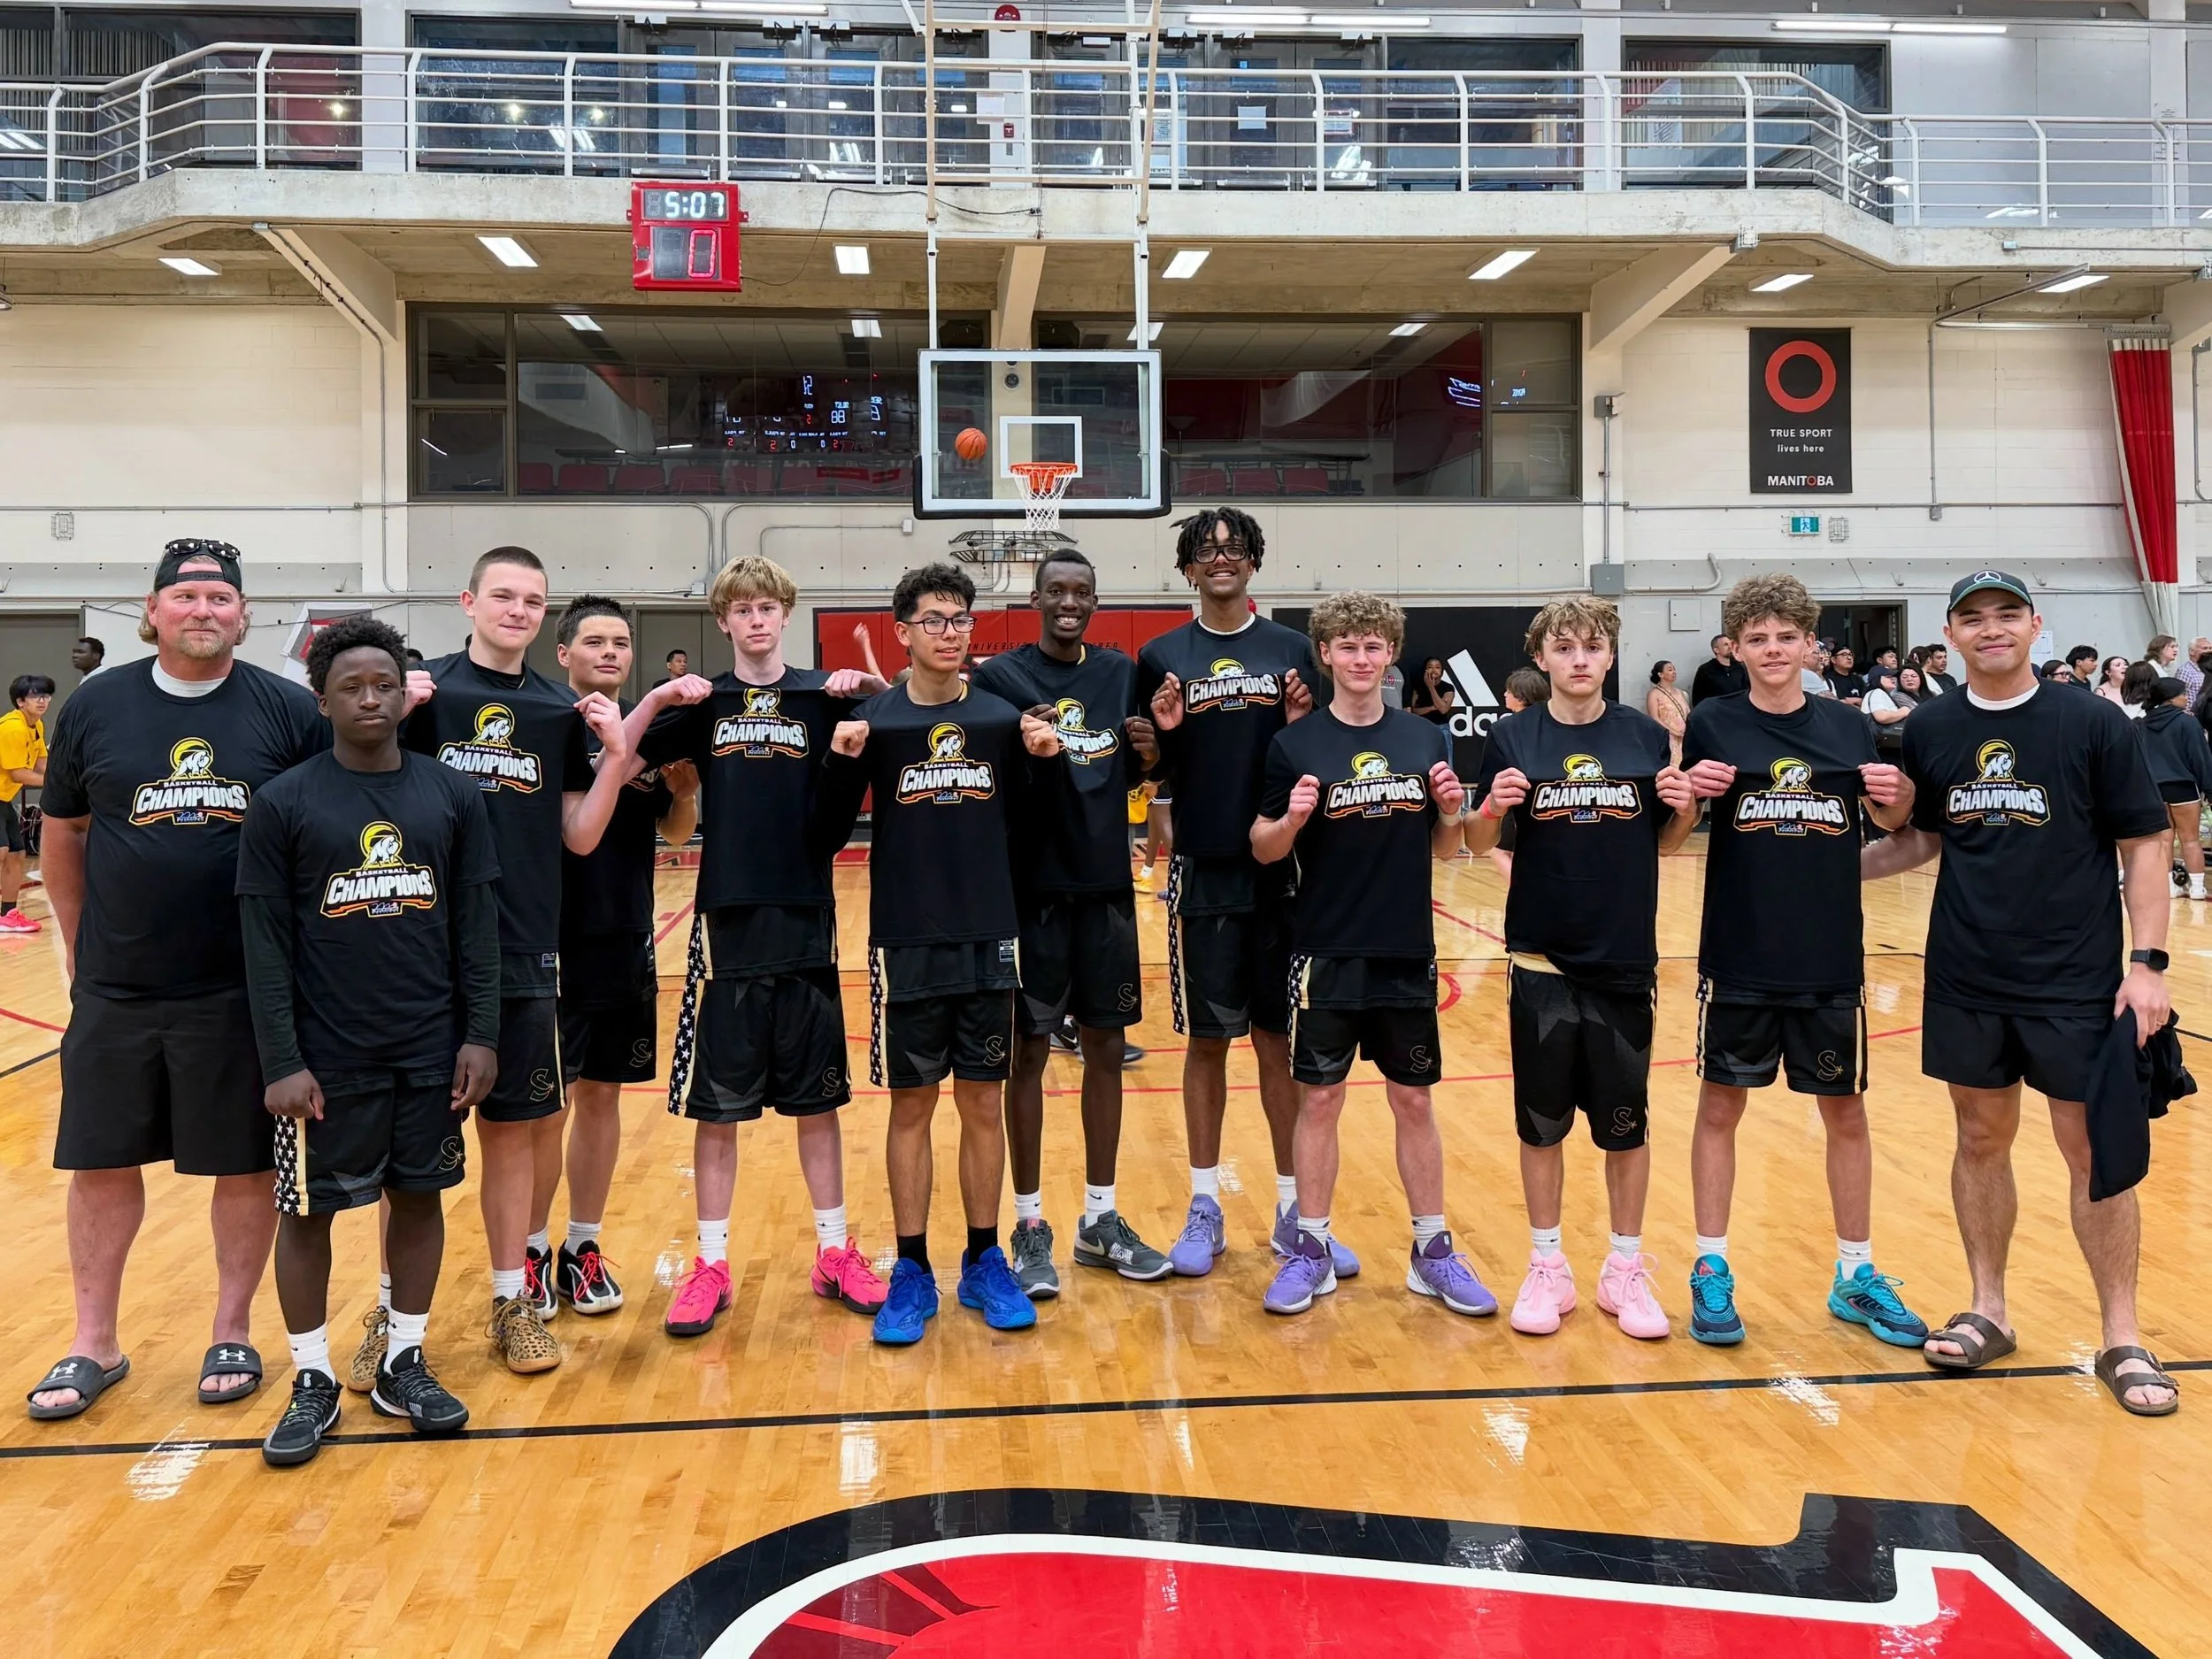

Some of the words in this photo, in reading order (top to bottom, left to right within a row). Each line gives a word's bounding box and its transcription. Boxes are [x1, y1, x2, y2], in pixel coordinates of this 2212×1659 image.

[665, 191, 725, 219] 5:07
[1770, 428, 1795, 438] TRUE
[1799, 428, 1833, 438] SPORT
[1777, 444, 1800, 453] lives
[1803, 444, 1824, 453] here
[1767, 475, 1834, 487] MANITOBA
[1189, 673, 1279, 704] CHAMPIONS
[715, 721, 806, 747] CHAMPIONS
[465, 745, 513, 756] BASKETBALL
[901, 765, 992, 793] CHAMPIONS
[1351, 776, 1396, 787] BASKETBALL
[135, 785, 248, 813] CHAMPIONS
[1329, 778, 1425, 808] CHAMPIONS
[1535, 784, 1636, 810] CHAMPIONS
[1948, 787, 2046, 814] CHAMPIONS
[1738, 796, 1844, 824] CHAMPIONS
[355, 867, 409, 878] BASKETBALL
[326, 870, 434, 904] CHAMPIONS
